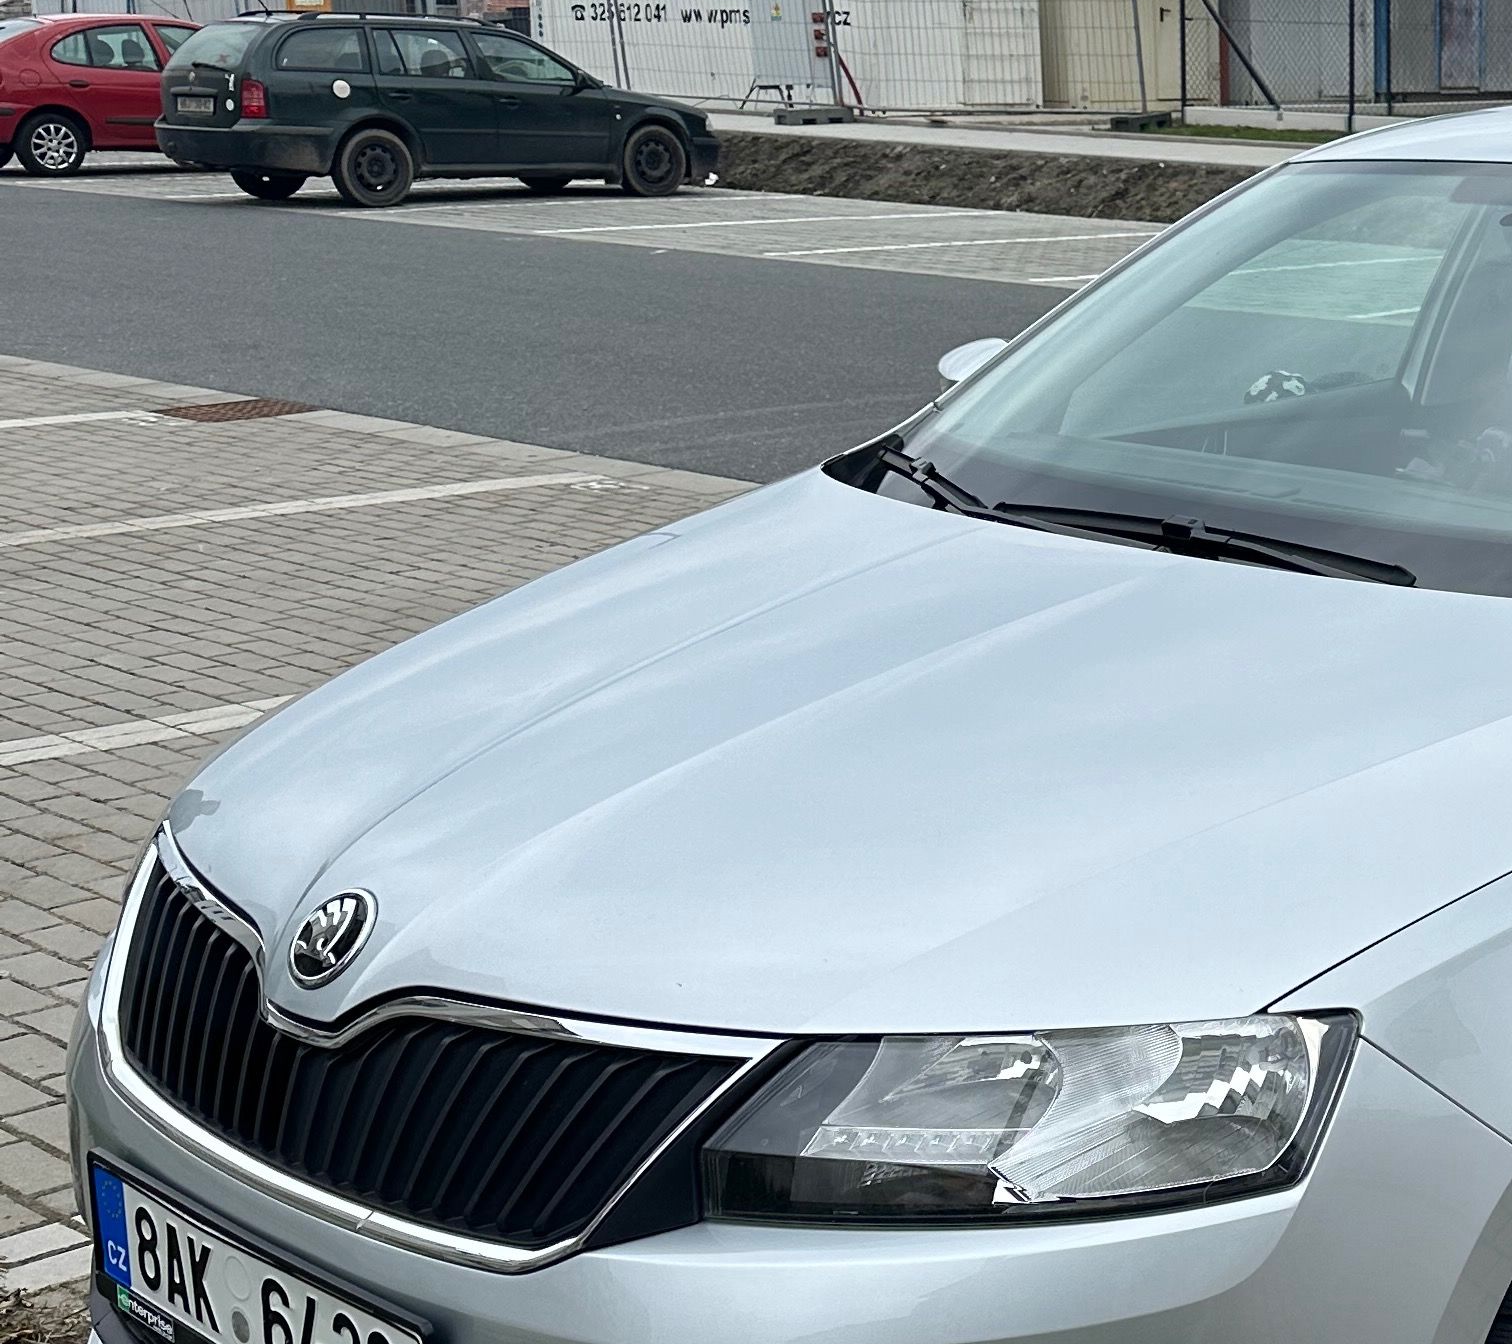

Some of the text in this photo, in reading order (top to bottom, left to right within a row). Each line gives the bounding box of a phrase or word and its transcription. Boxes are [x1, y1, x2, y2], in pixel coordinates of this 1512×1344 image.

[619, 3, 642, 22] 612
[644, 3, 667, 22] 041
[107, 1240, 127, 1272] CZ
[135, 1206, 221, 1334] 8AK
[119, 1293, 173, 1335] enterprise
